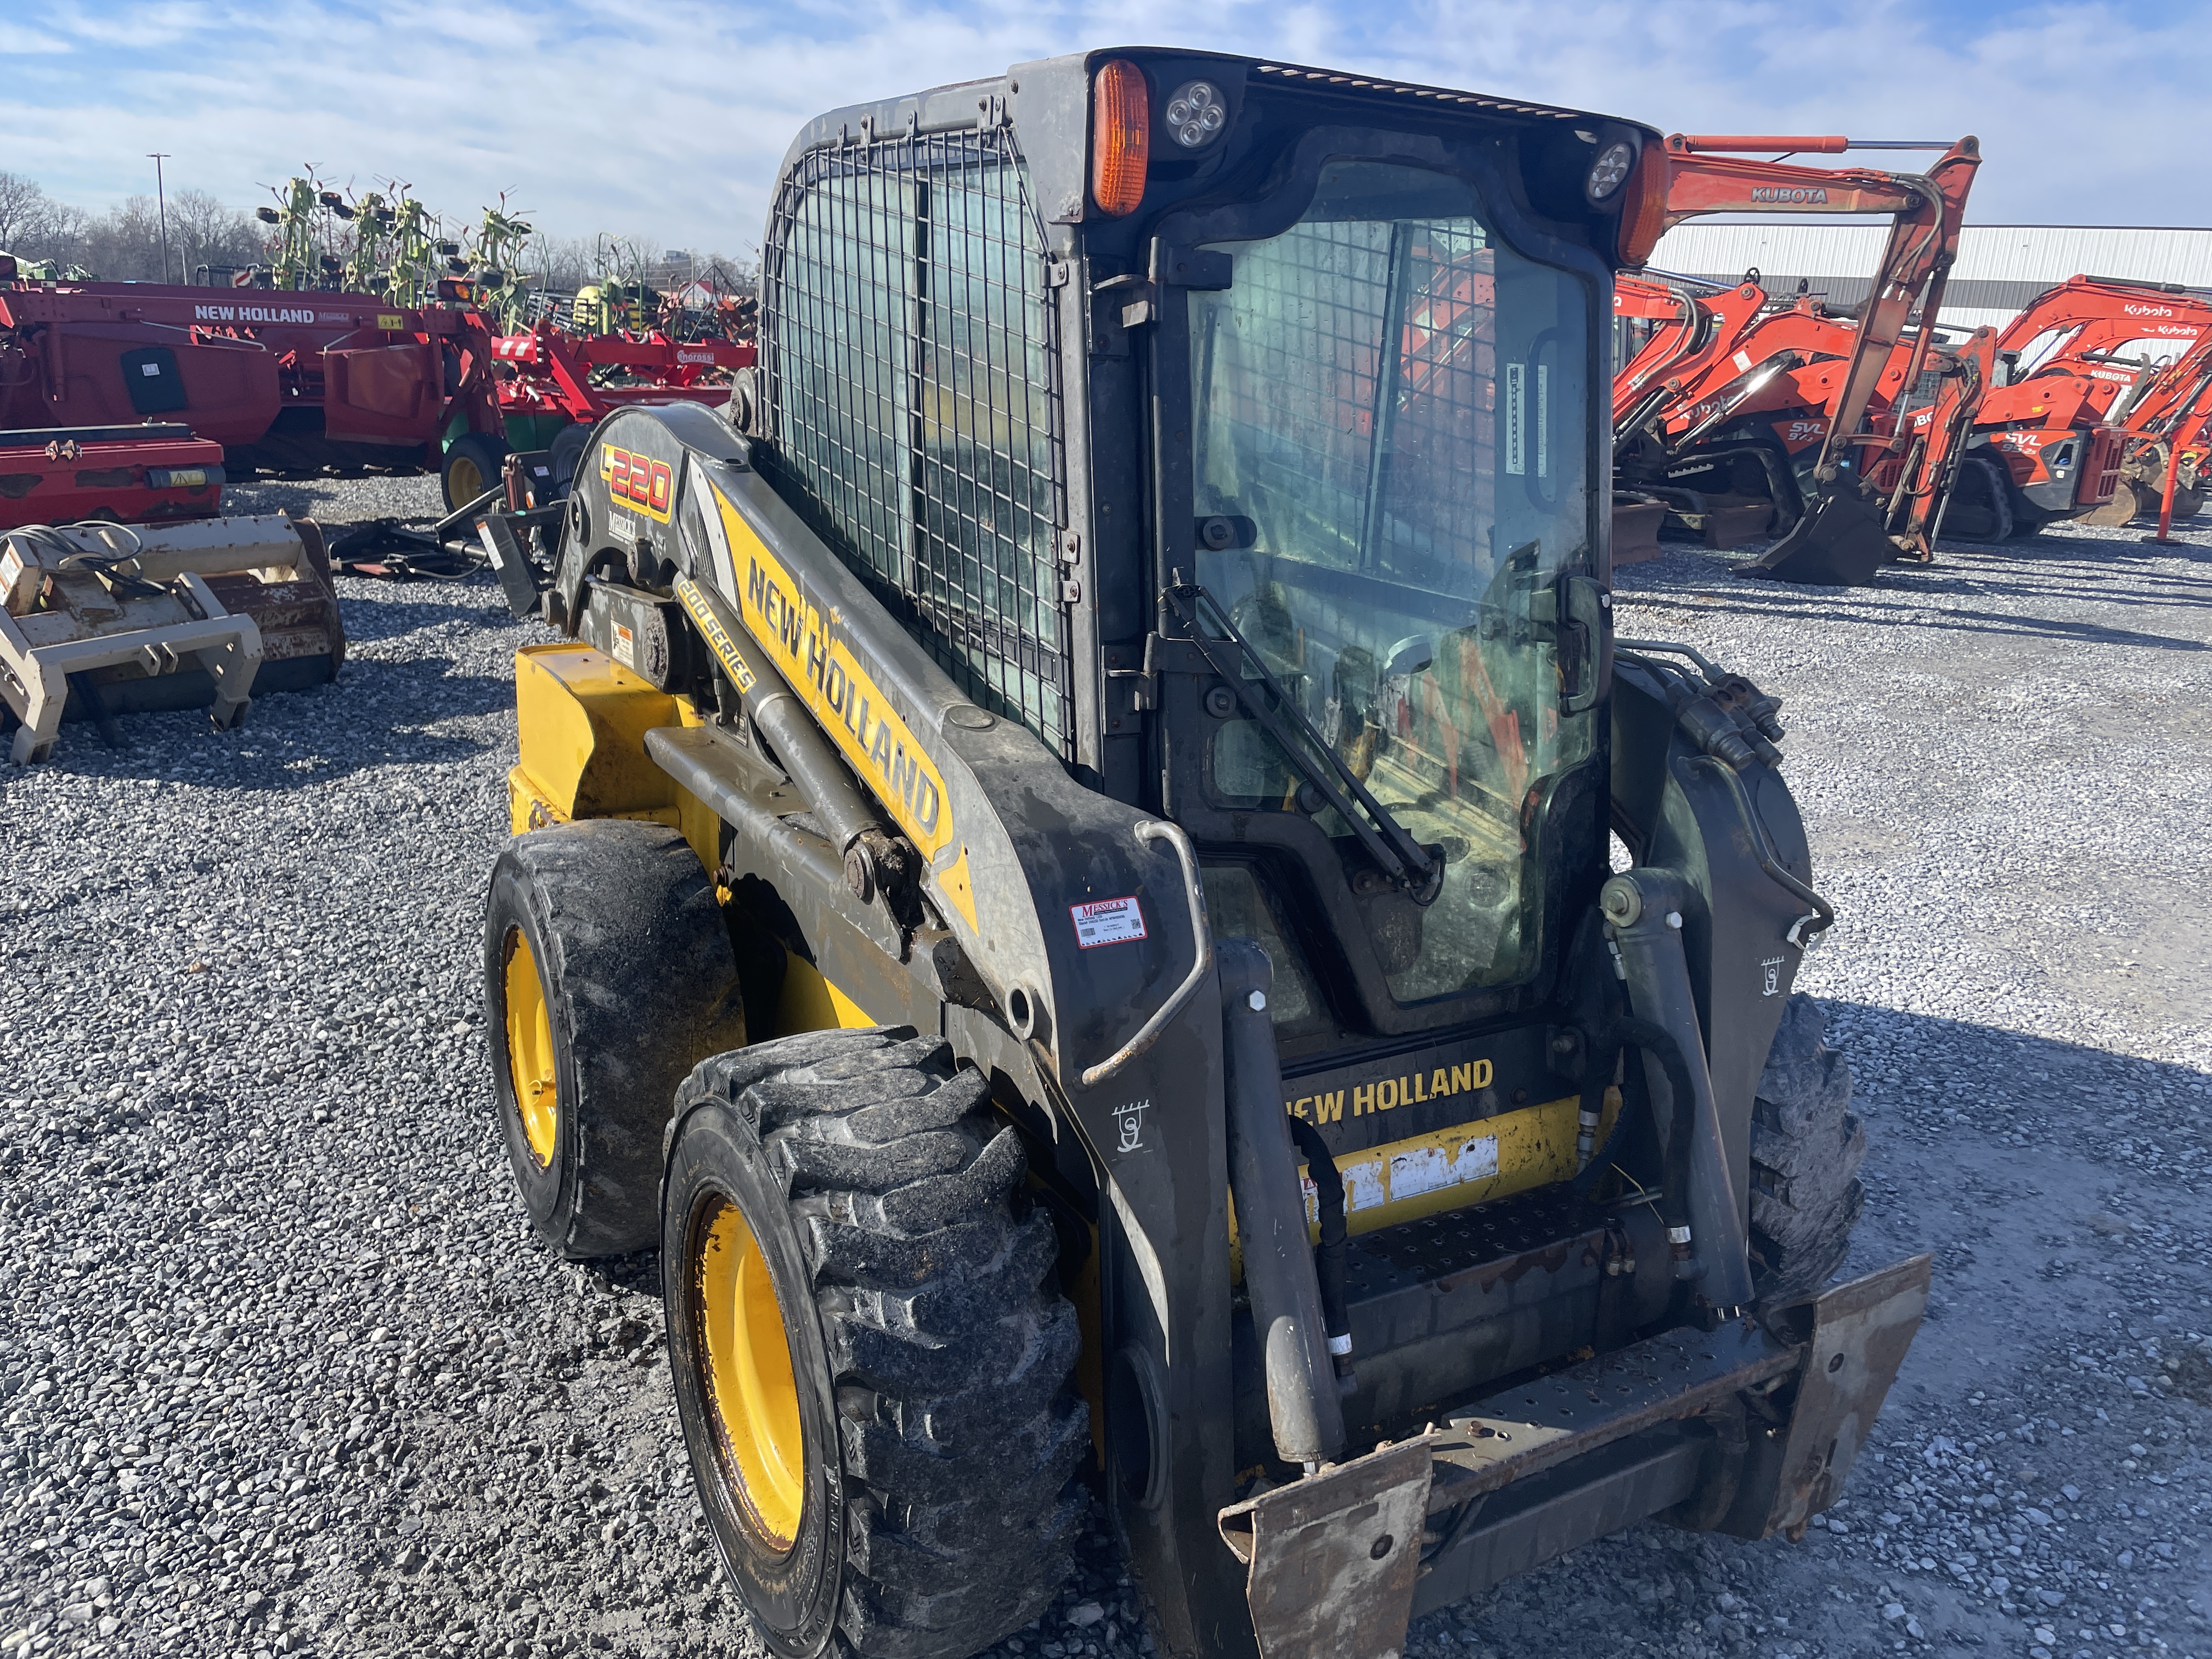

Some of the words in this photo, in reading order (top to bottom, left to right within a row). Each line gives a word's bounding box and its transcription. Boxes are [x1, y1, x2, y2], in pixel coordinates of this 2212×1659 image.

[1751, 188, 1827, 204] KUBOTA
[195, 305, 234, 320] NEW
[238, 307, 314, 324] HOLLAND
[2124, 304, 2172, 317] Kubota
[2158, 325, 2198, 336] Kubota
[2091, 370, 2131, 382] KUBOTA
[1789, 422, 1825, 435] SVL
[2006, 433, 2042, 446] SVL
[601, 444, 673, 520] L220
[679, 580, 708, 618] 200
[703, 619, 755, 690] SERIES
[748, 555, 804, 661] NEW
[806, 629, 940, 836] HOLLAND
[1082, 900, 1128, 918] MESSICK'S
[1286, 1090, 1345, 1126] EW
[1353, 1058, 1493, 1116] HOLLAND
